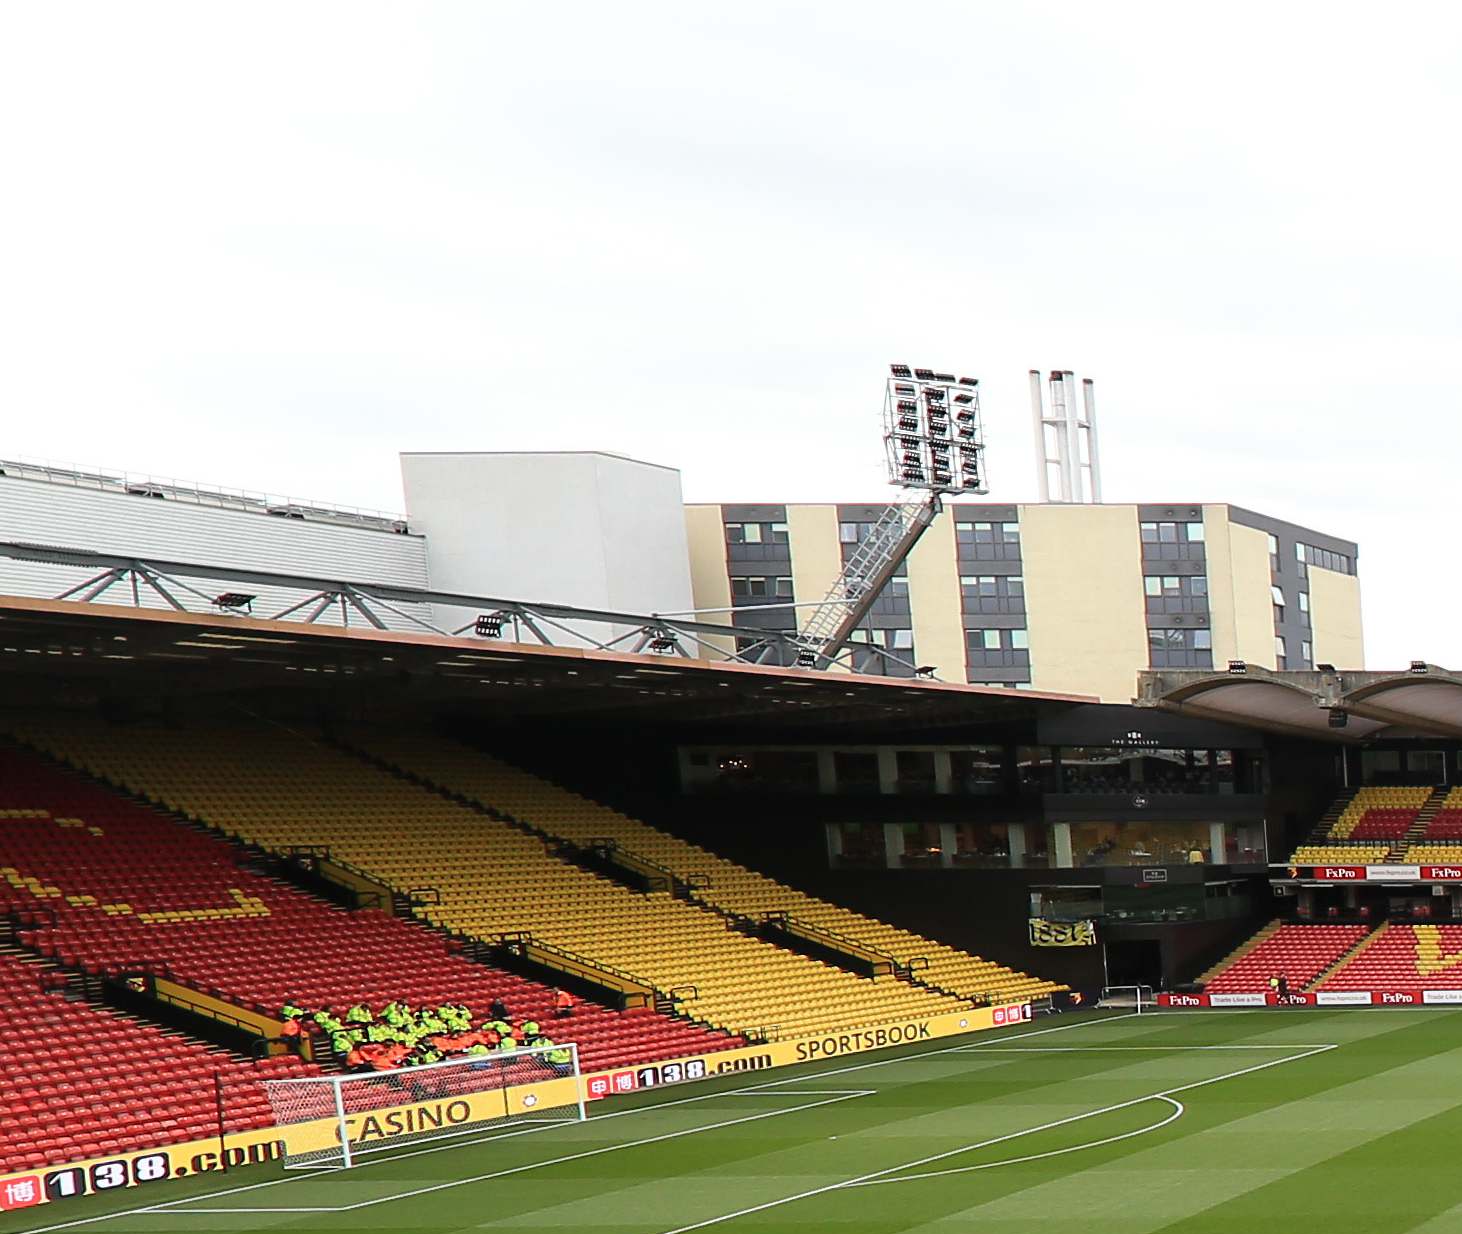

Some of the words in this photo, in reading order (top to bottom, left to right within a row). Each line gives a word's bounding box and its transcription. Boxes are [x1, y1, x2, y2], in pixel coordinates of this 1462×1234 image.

[1326, 869, 1356, 878] FxPro
[1432, 868, 1462, 878] FxPro
[1170, 995, 1200, 1005] FxPro
[1382, 993, 1413, 1003] FxPro
[796, 1021, 931, 1061] SPORTSBOOK
[638, 1054, 772, 1088] 138.com
[335, 1100, 471, 1144] CASINO
[46, 1139, 285, 1199] 138.com
[4, 1180, 36, 1206] 博
